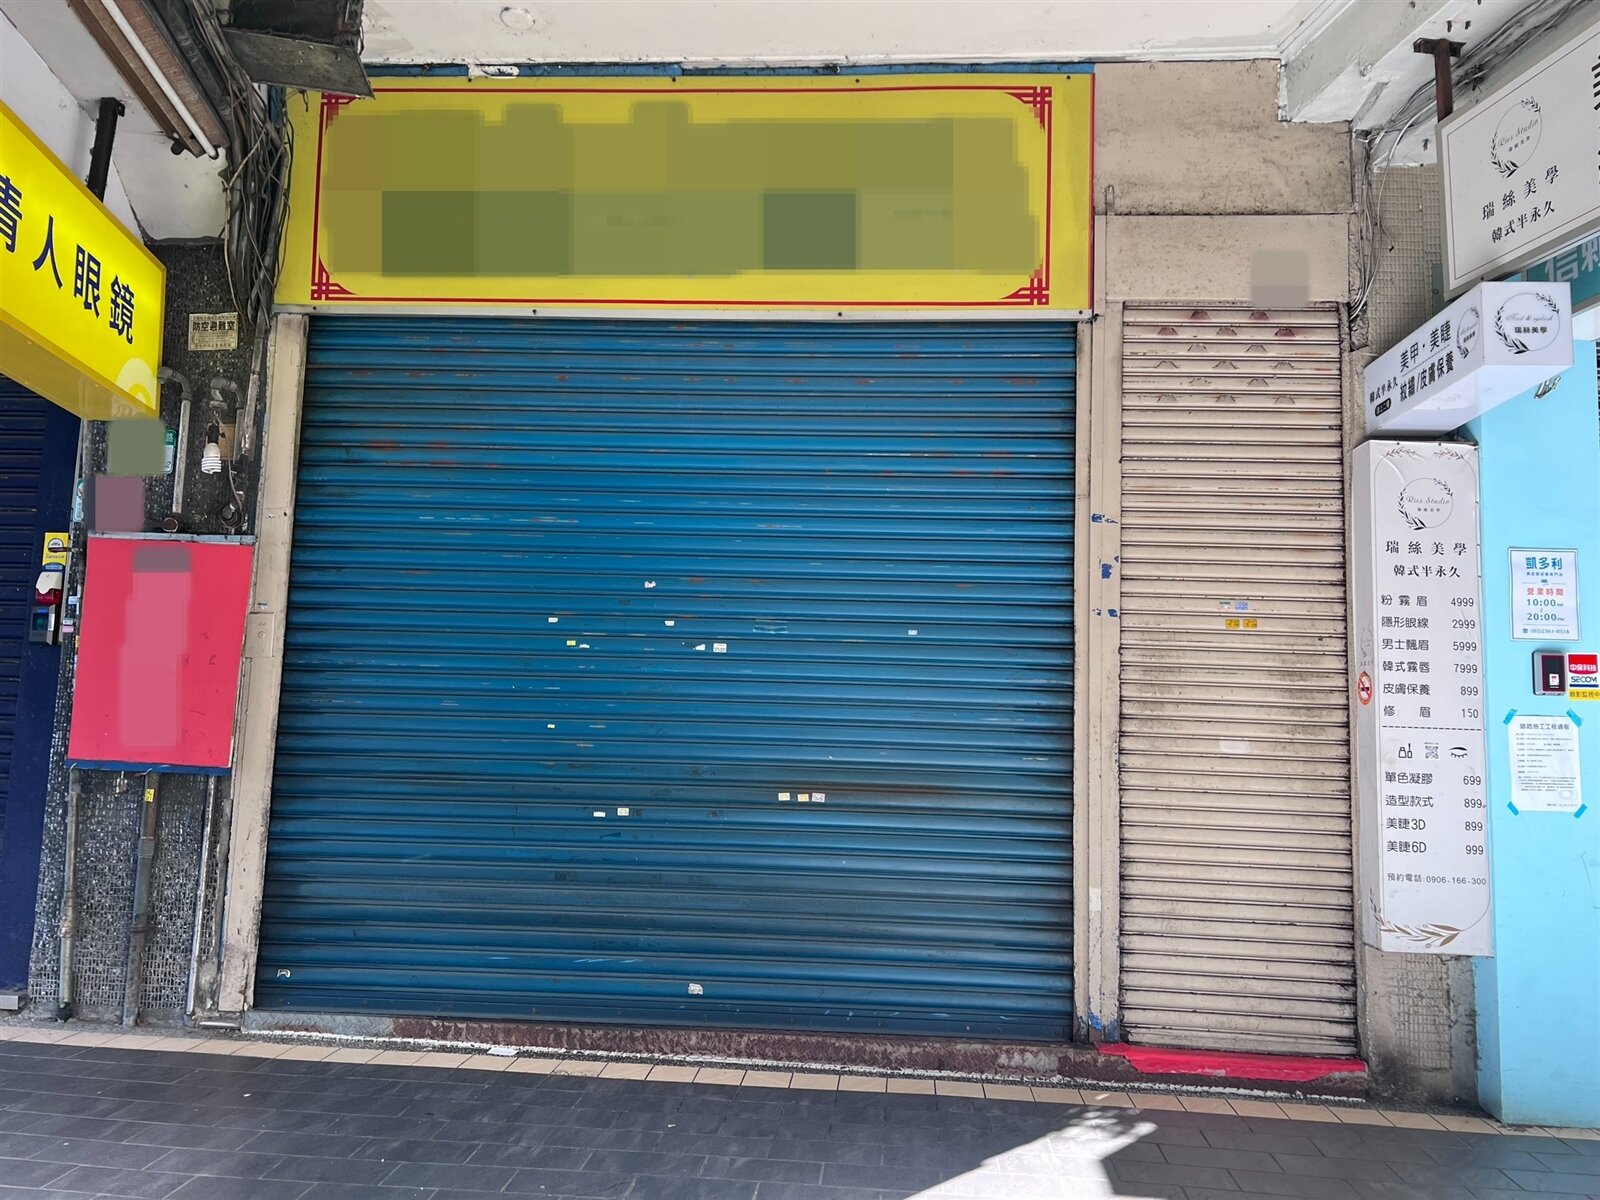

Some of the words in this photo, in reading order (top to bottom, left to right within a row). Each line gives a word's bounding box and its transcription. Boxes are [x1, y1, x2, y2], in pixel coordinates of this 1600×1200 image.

[1482, 165, 1559, 220] 瑞絲美學
[1492, 200, 1555, 243] 韓式半永久
[1385, 540, 1467, 556] 瑞絲美學
[1525, 557, 1562, 570] 凱多利
[1393, 564, 1460, 578] 韓式半永久
[1527, 587, 1563, 596] 營業時間
[1450, 598, 1474, 607] 4999
[1527, 599, 1556, 607] 10:00
[1381, 616, 1429, 629] 隱形眼線
[1452, 619, 1476, 629] 2999
[1527, 613, 1557, 621] 20:00
[1453, 641, 1477, 651] 5999
[1382, 661, 1430, 673] 韓式霧唇
[1454, 663, 1478, 673] 7999
[1383, 683, 1430, 695] 皮膚保養
[1460, 686, 1479, 696] 899
[1461, 709, 1479, 718] 150
[1385, 772, 1433, 784] 單色凝膠
[1463, 775, 1481, 785] 699
[1385, 795, 1434, 807] 造型款式
[1464, 798, 1482, 808] 899
[1386, 818, 1426, 830] 美睫3D
[1465, 821, 1483, 831] 899
[1387, 840, 1427, 853] 美睫6D
[1465, 845, 1484, 855] 999
